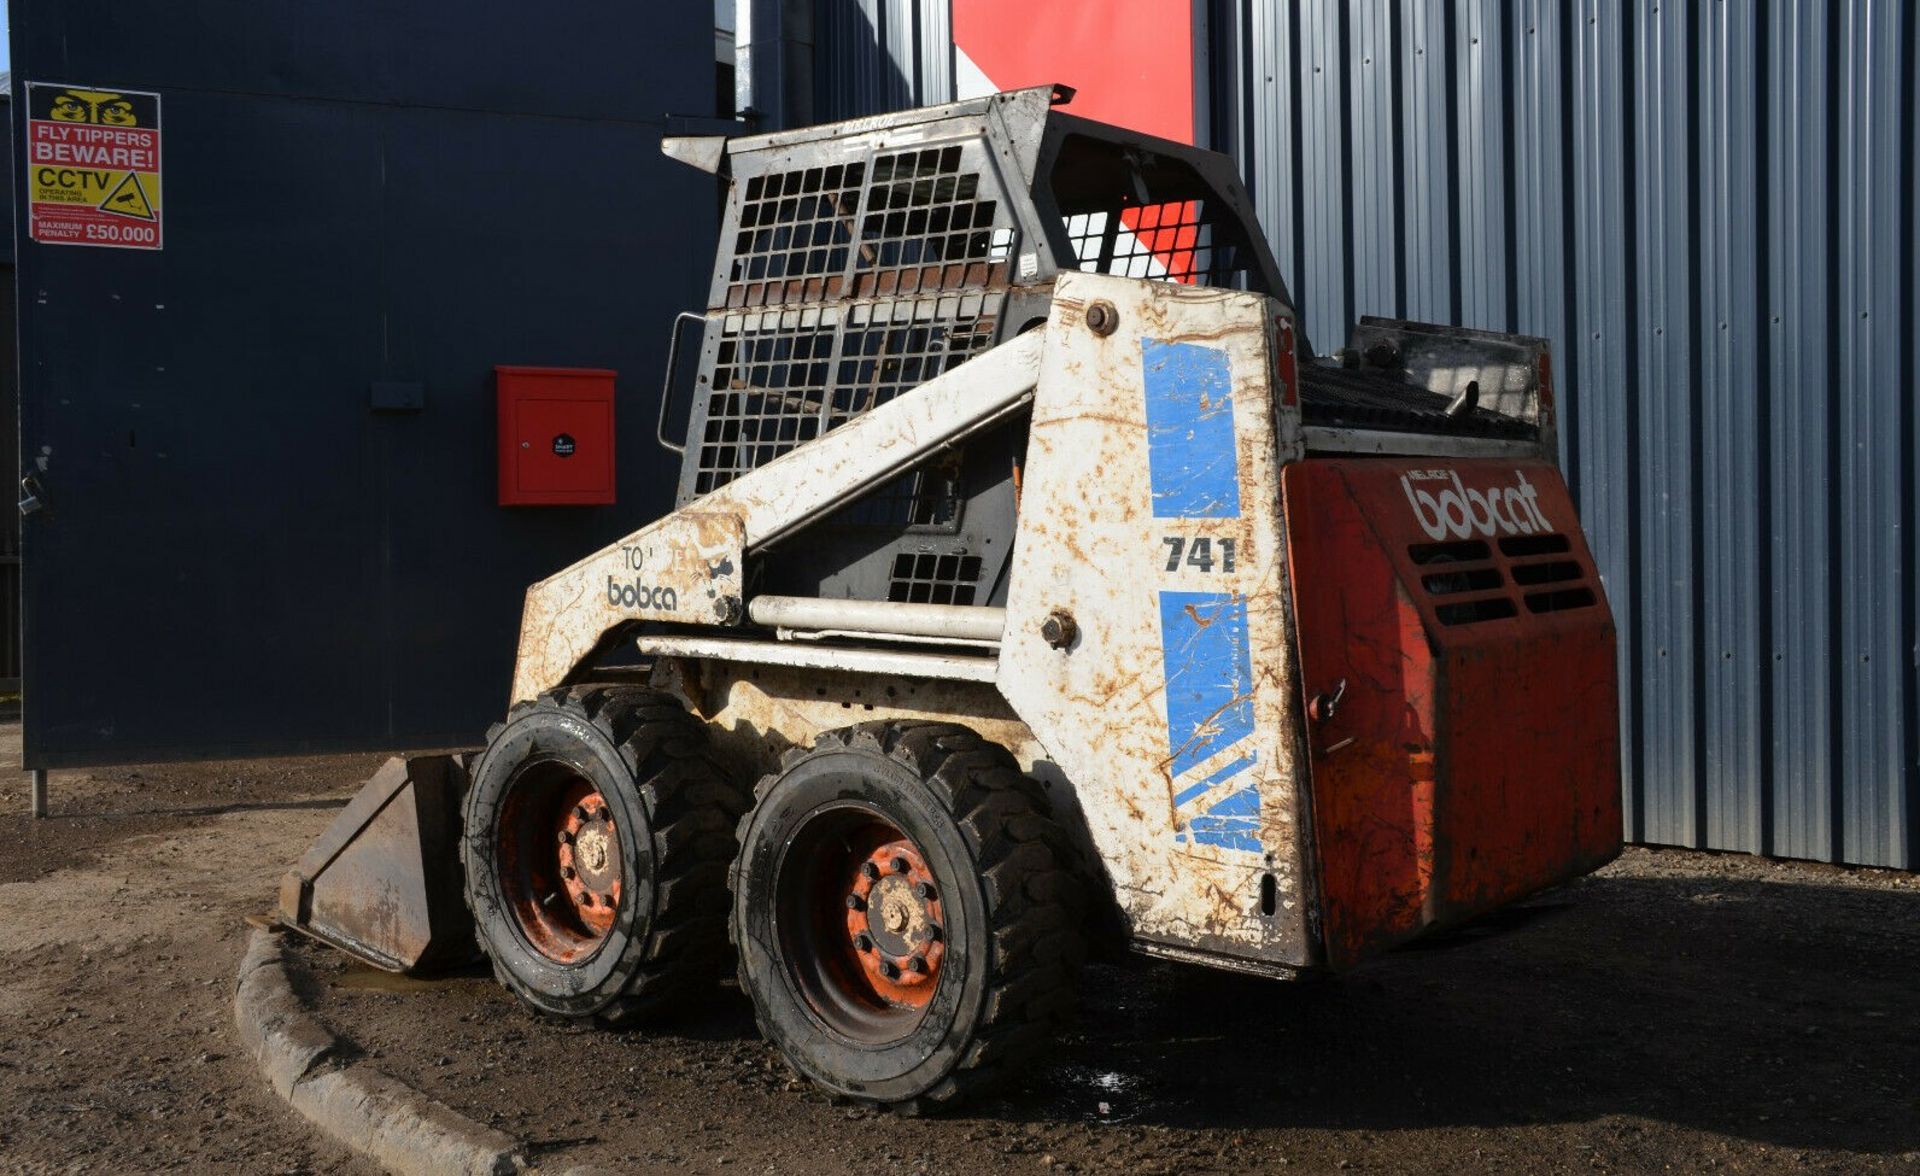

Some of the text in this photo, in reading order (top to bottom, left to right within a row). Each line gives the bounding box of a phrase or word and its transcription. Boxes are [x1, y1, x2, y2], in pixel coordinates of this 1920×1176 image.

[37, 125, 151, 148] FLY TIPPERS
[36, 142, 153, 168] BEWARE!
[38, 168, 110, 190] CCTV
[39, 188, 82, 197] OPERATING
[39, 221, 82, 231] MAXIMUM
[39, 223, 154, 242] PENALTY £50,000
[1400, 469, 1554, 541] bobcat
[1163, 537, 1236, 573] 741
